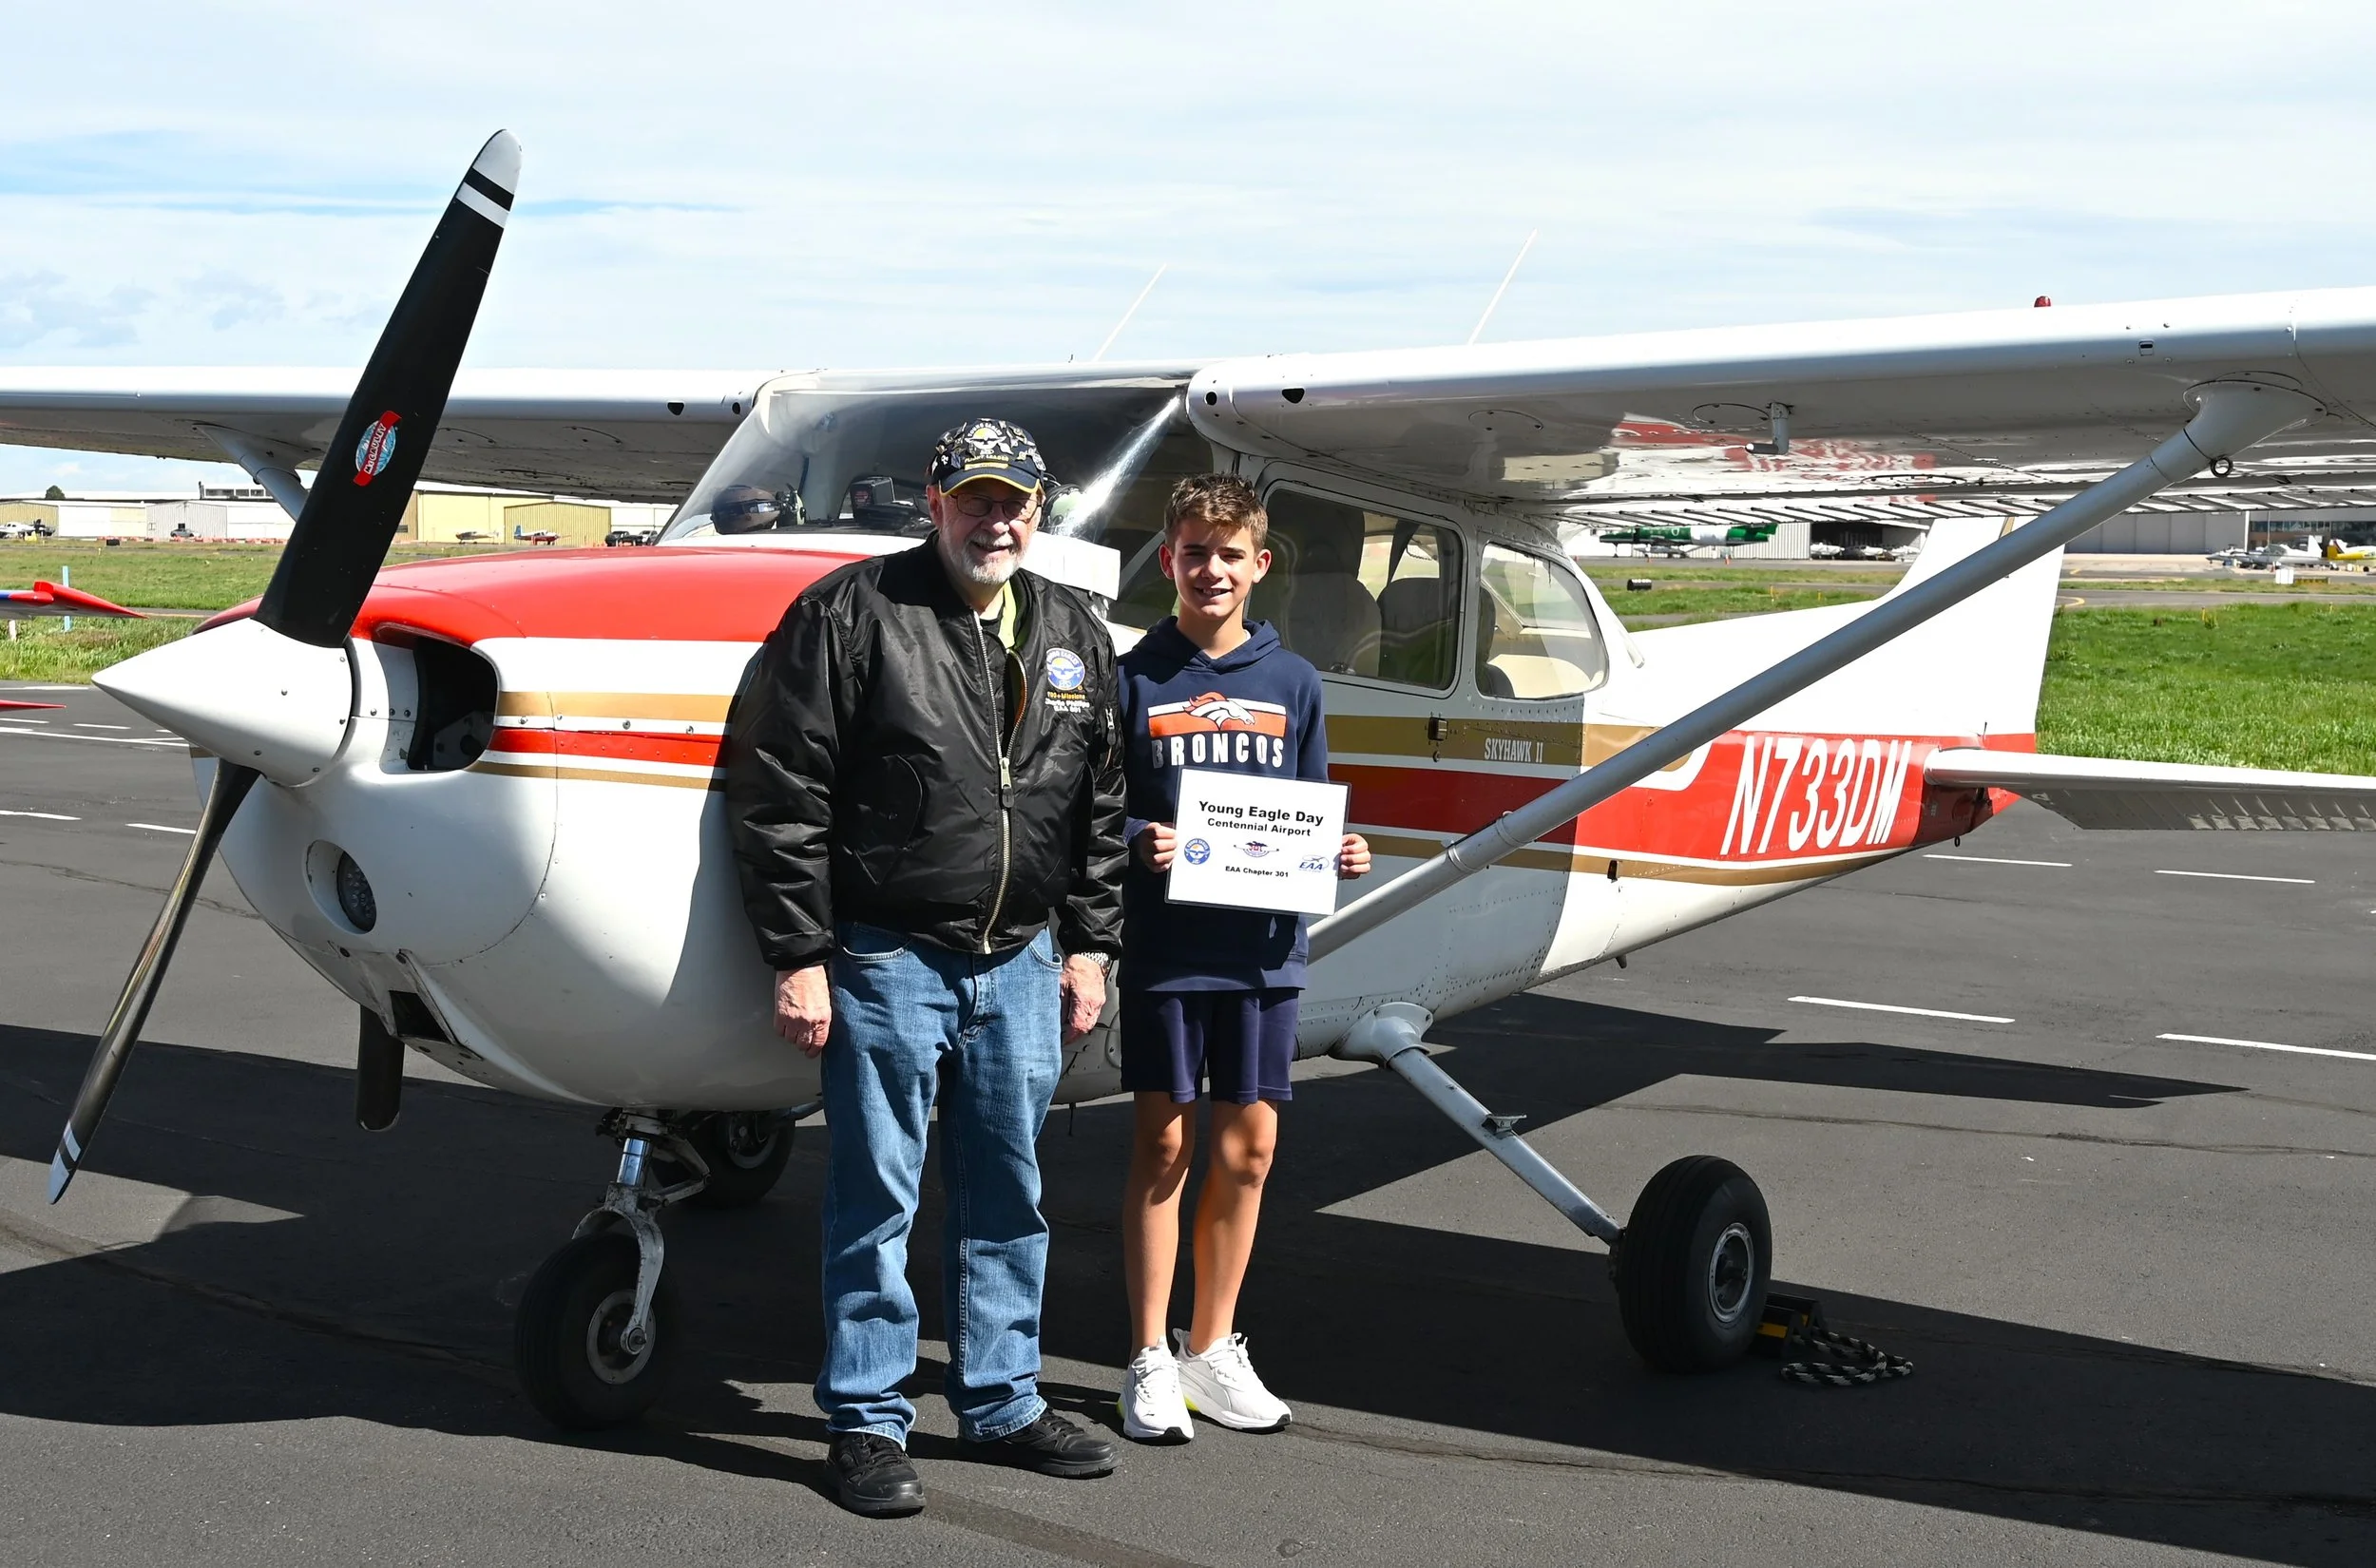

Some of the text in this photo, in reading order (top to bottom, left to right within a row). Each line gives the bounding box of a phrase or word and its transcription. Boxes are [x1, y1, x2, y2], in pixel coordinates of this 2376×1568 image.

[363, 423, 387, 474] McCAULEY
[1151, 733, 1284, 769] BRONCOS
[1485, 737, 1543, 763] SKYHAWK II
[1719, 736, 1912, 855] N733DM
[1198, 800, 1324, 827] Young Eagle Day
[1207, 818, 1312, 836] Centennial Airport
[1243, 868, 1273, 876] Chapter
[1298, 861, 1323, 870] EAA
